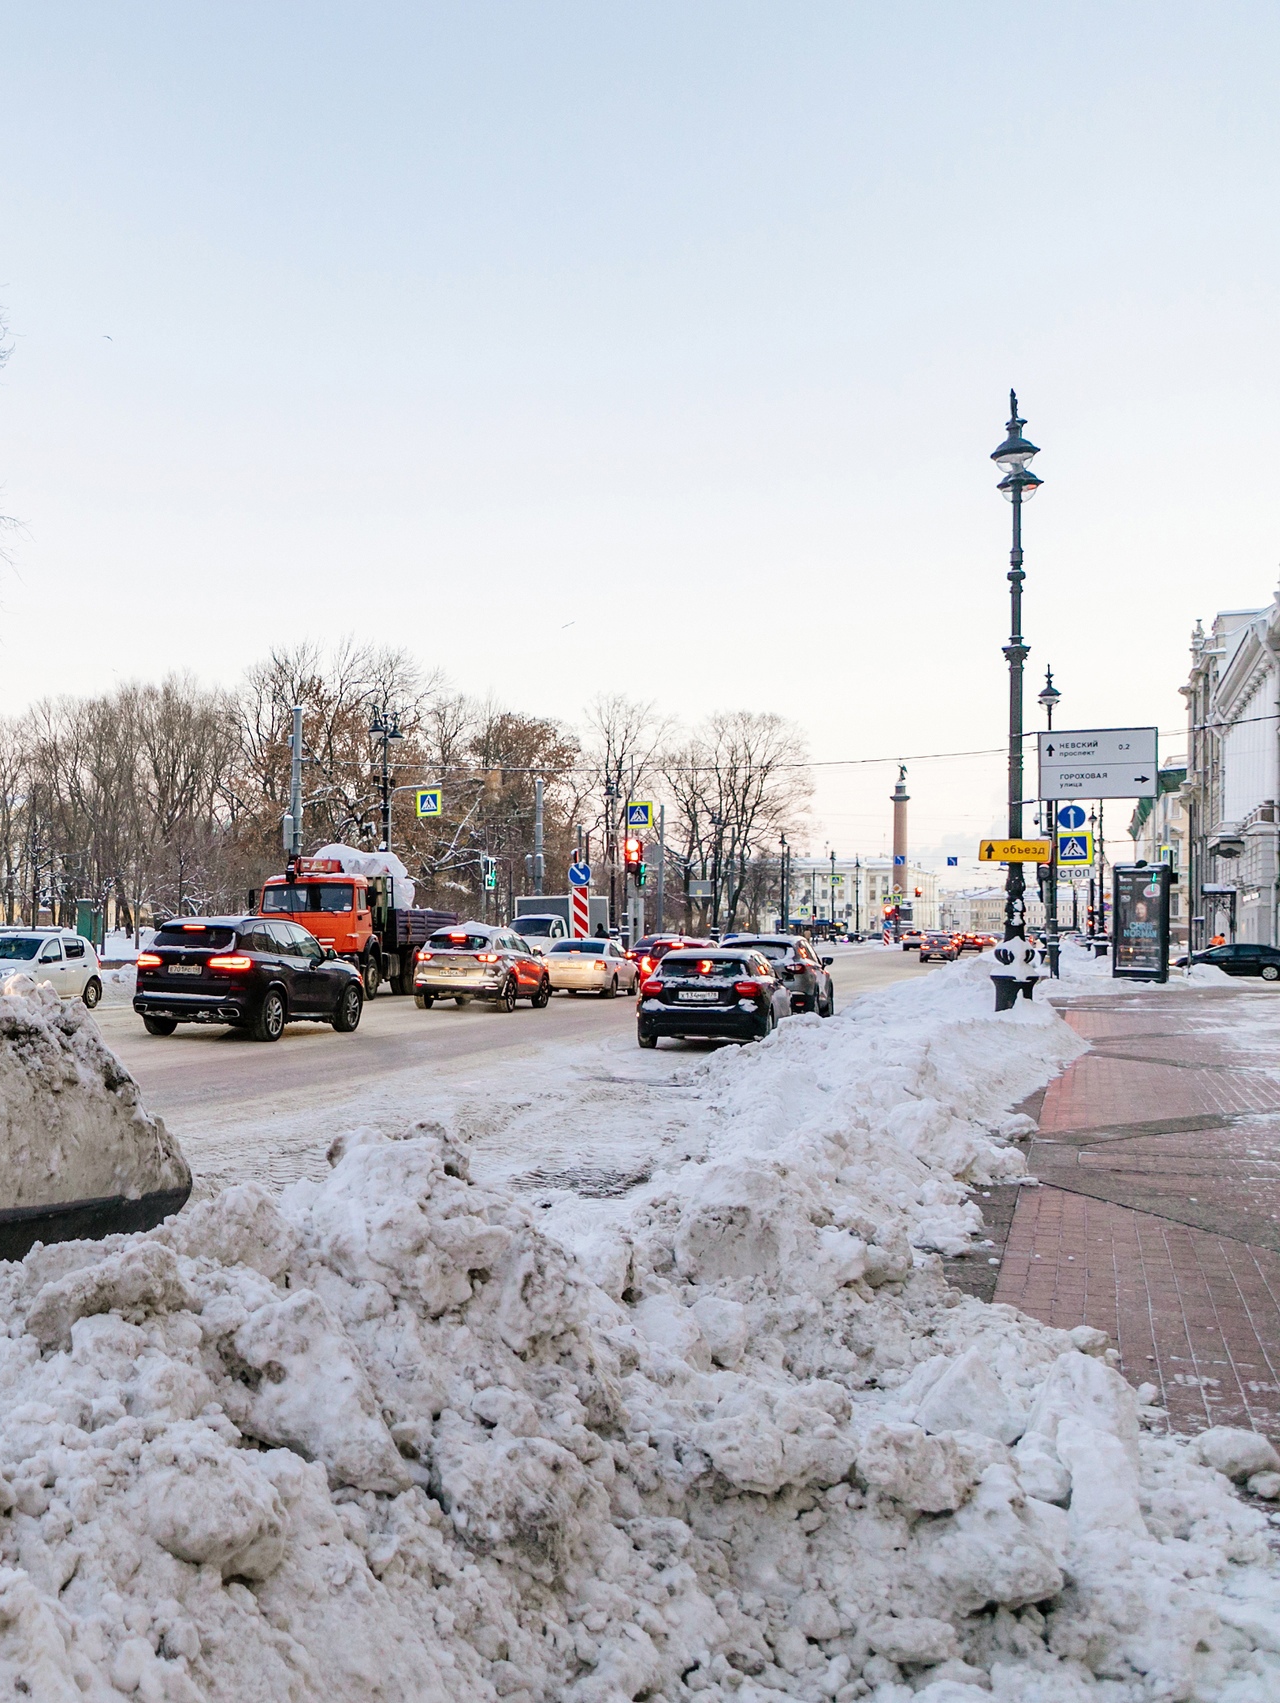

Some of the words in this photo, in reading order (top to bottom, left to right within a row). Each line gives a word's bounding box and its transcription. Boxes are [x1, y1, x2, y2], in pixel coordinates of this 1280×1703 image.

[1059, 740, 1099, 749] НЕВСКИЙ
[1059, 772, 1108, 780] ГОРОХОВАЯ
[1059, 868, 1090, 878] СТОП
[1123, 929, 1157, 938] NORMAN
